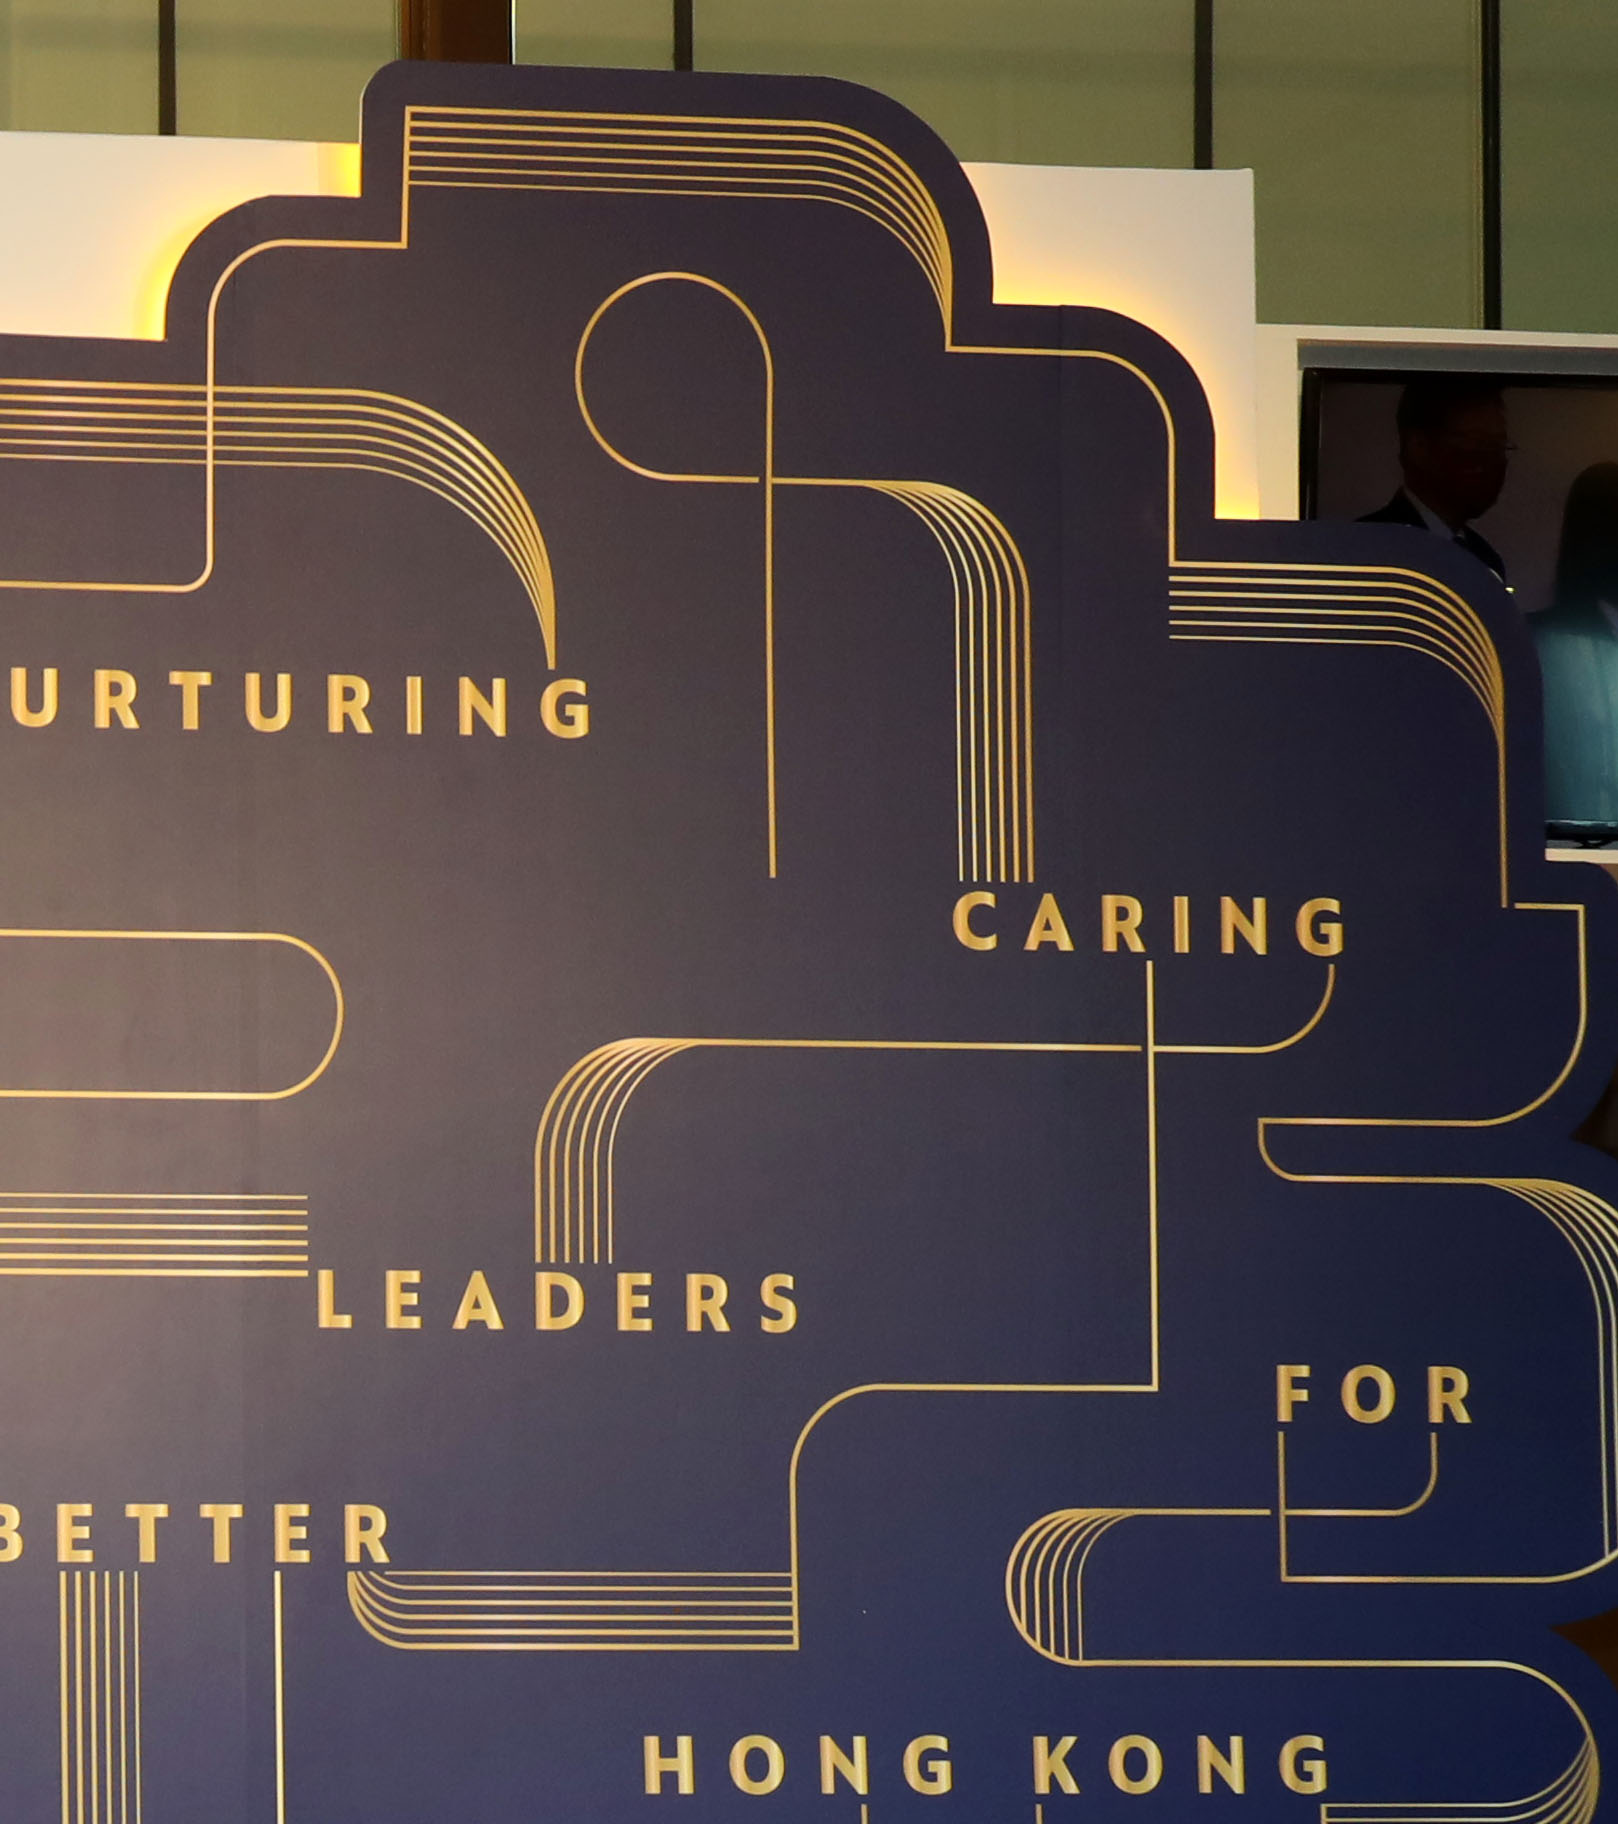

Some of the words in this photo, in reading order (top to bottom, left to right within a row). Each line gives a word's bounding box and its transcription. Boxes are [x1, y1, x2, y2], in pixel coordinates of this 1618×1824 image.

[953, 890, 1346, 960] CARING
[318, 1269, 800, 1335] LEADERS
[1277, 1364, 1473, 1425] FOR
[644, 1734, 956, 1797] HONG
[1036, 1734, 1331, 1797] KONG
